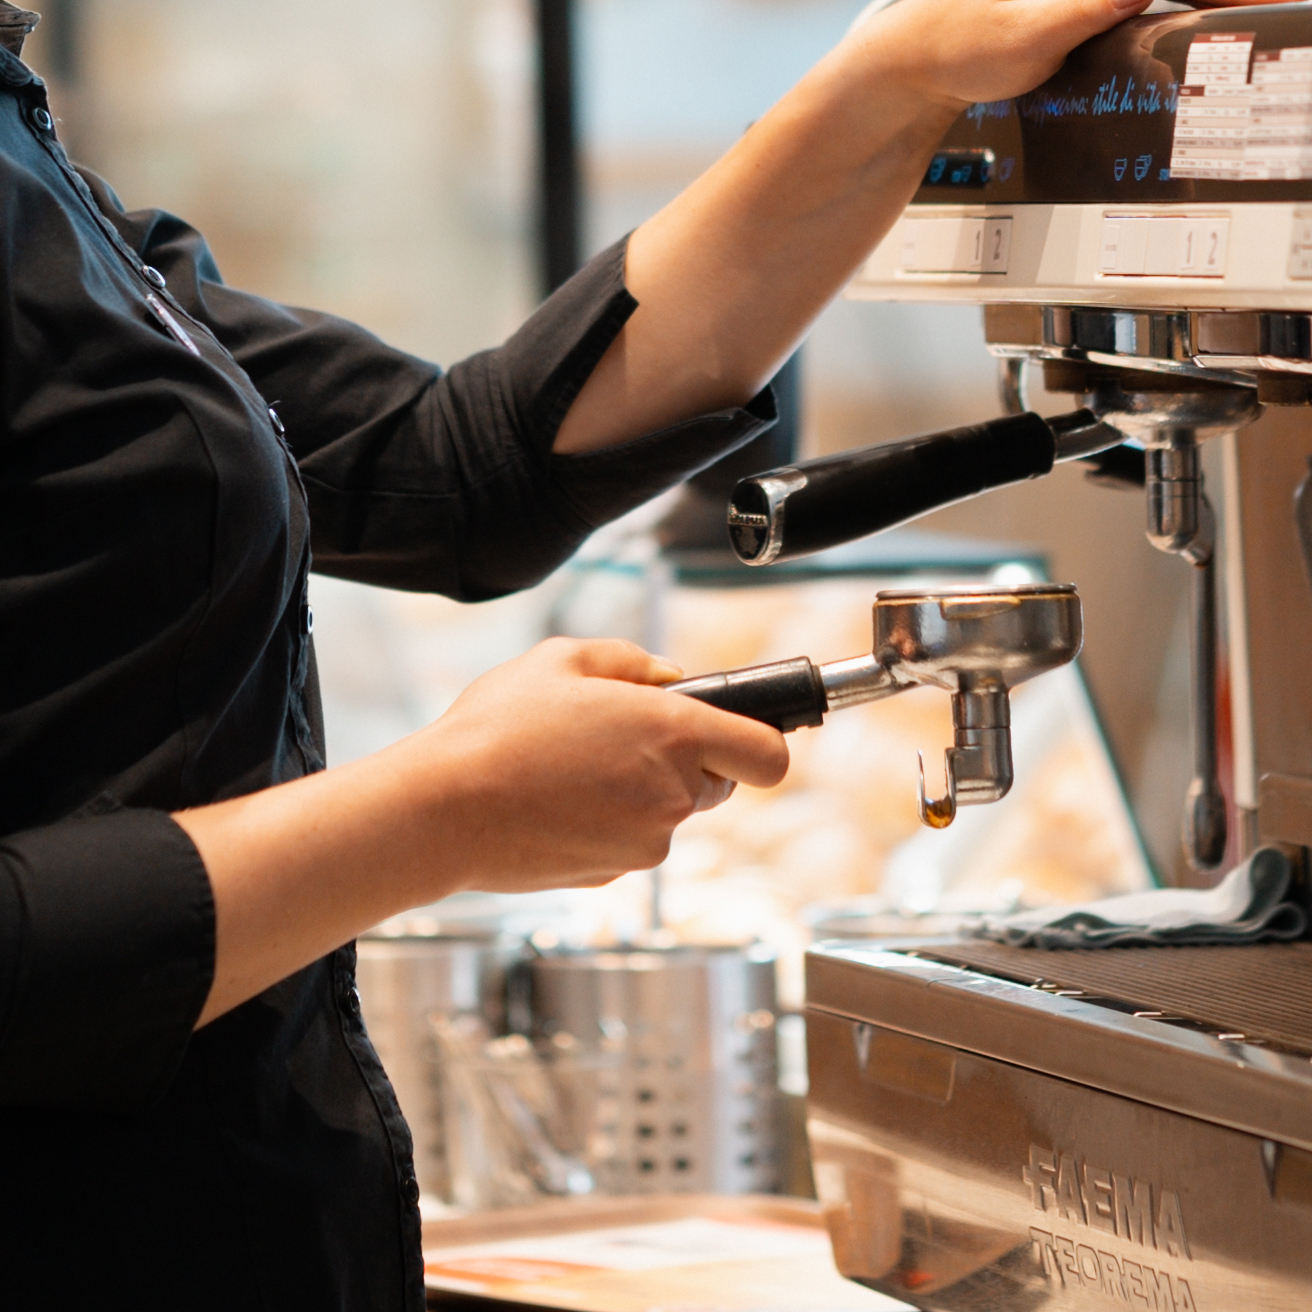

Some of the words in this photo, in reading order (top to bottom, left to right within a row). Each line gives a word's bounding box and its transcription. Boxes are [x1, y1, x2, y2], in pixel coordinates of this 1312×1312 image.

[1091, 75, 1118, 115] stile
[1119, 76, 1135, 114] di
[993, 228, 1003, 261] 2
[1207, 230, 1218, 266] 2
[1022, 1145, 1193, 1262] FAEMA
[1029, 1225, 1198, 1312] TEOREMA
